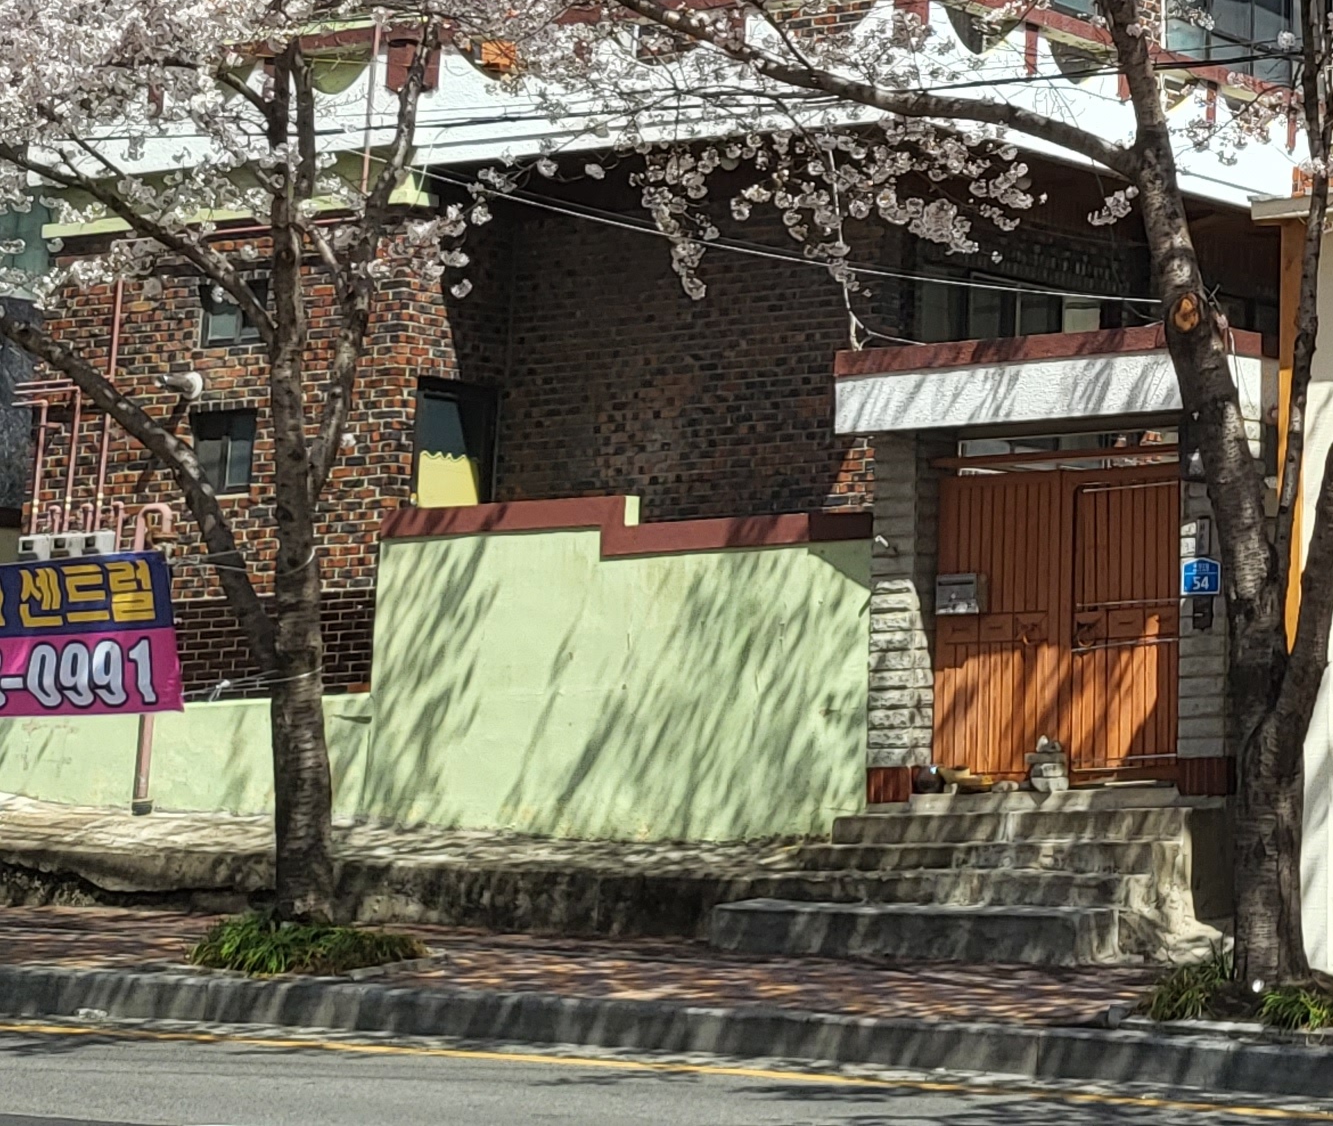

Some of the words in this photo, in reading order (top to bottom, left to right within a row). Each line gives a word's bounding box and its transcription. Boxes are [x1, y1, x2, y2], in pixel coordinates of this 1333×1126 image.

[19, 559, 156, 627] 센트럴
[1193, 576, 1209, 590] 54
[0, 637, 157, 708] -0991
